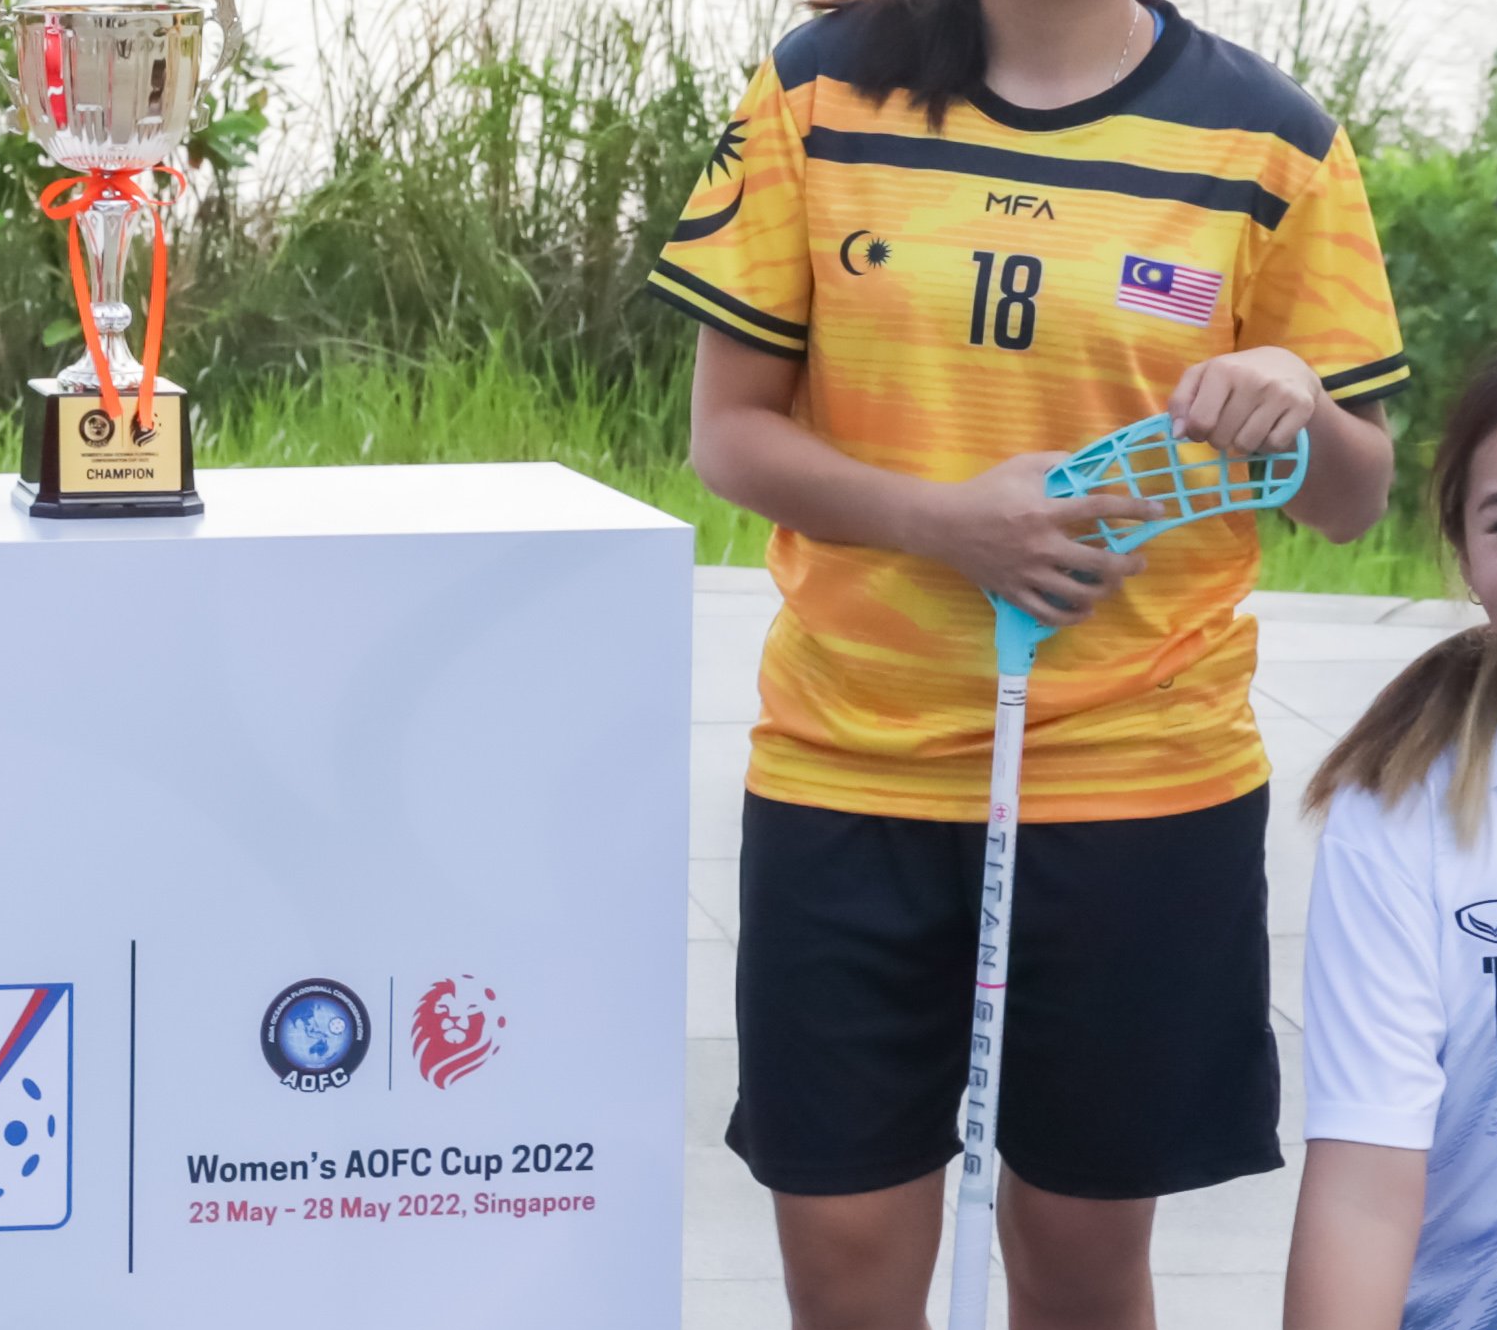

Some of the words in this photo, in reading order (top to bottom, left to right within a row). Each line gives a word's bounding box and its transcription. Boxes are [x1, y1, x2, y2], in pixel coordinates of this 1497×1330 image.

[985, 191, 1055, 220] MFA
[969, 250, 1042, 350] 18
[86, 468, 155, 481] CHAMPION
[282, 1068, 350, 1092] AOFC
[344, 1147, 433, 1179] AOFC
[440, 1146, 504, 1181] Cup
[511, 1142, 595, 1174] 2022
[189, 1200, 220, 1224] 23
[226, 1200, 278, 1226] May
[302, 1196, 334, 1221] 28
[340, 1195, 392, 1222] May
[396, 1192, 467, 1219] 2022,
[473, 1191, 596, 1220] Singapore
